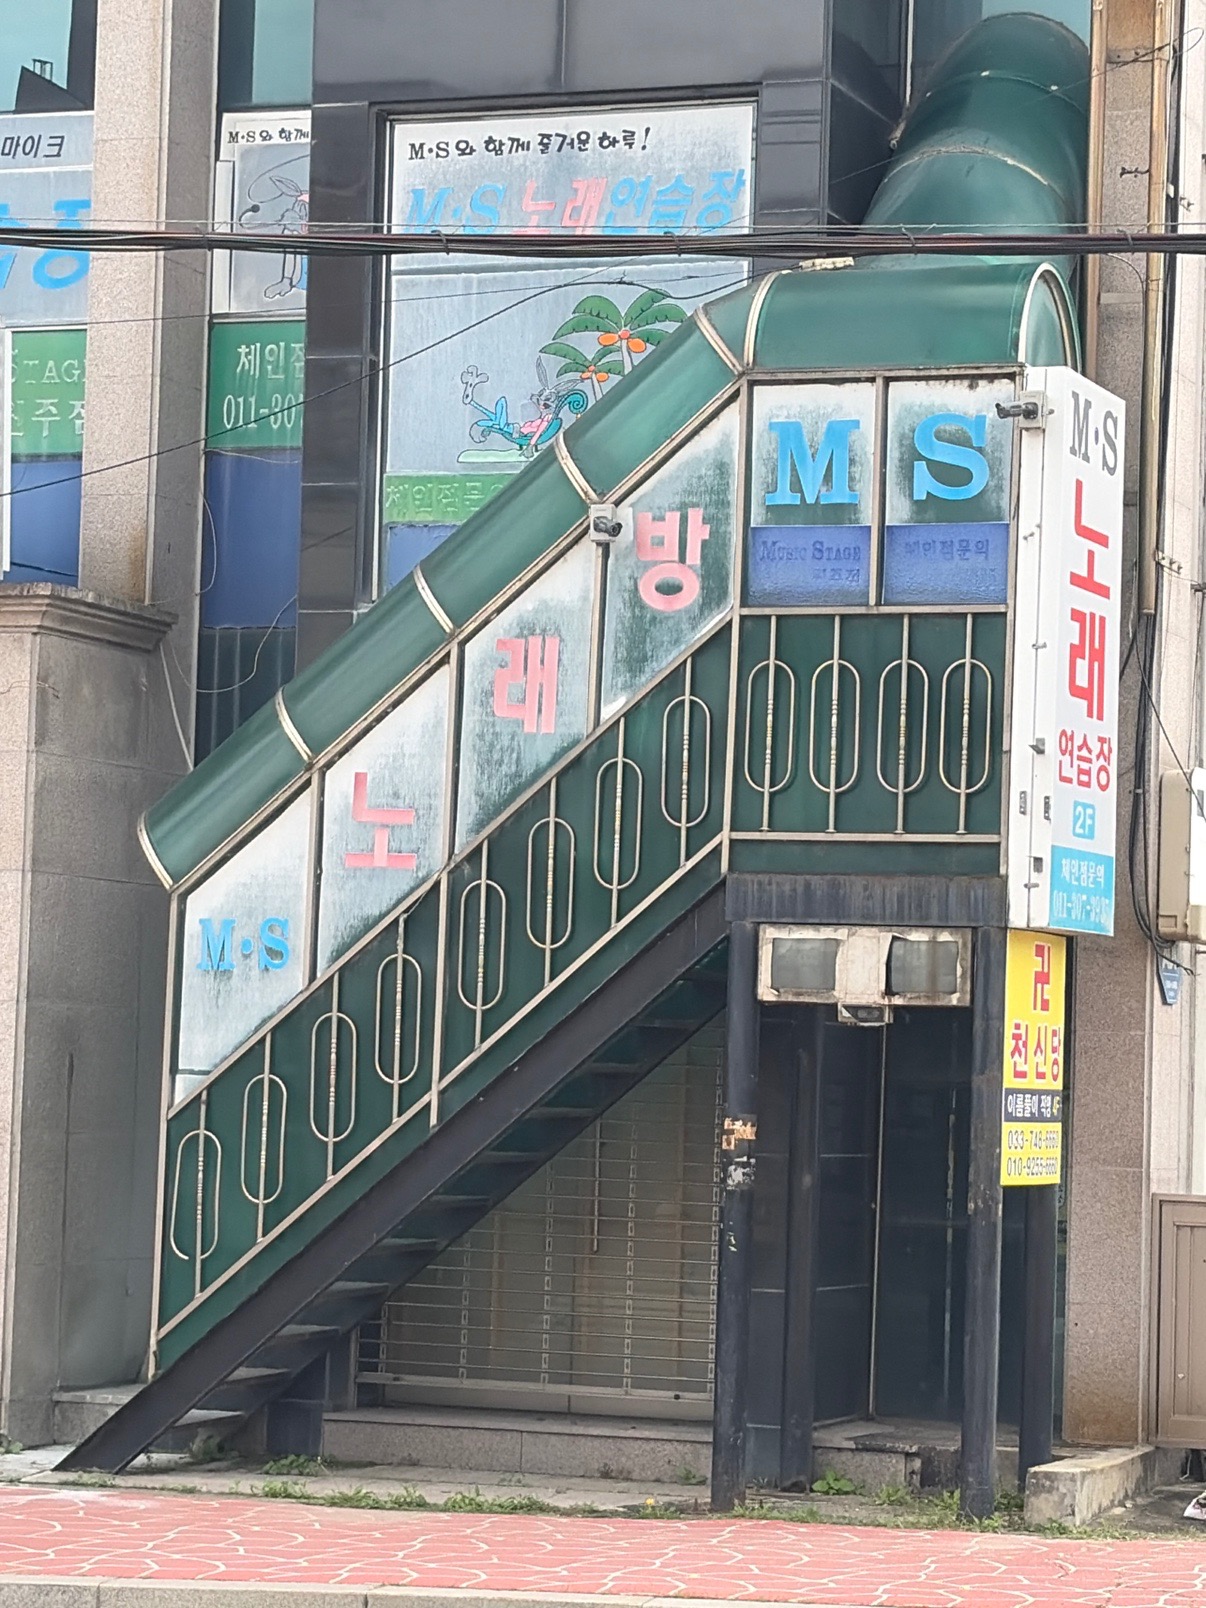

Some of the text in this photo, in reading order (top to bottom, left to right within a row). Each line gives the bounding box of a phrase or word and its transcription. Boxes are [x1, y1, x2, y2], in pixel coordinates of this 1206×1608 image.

[484, 135, 531, 157] 함께
[537, 130, 591, 155] 즐거운
[597, 126, 651, 152] 하루!
[402, 183, 507, 234] M·S
[1069, 390, 1118, 476] M·S
[1059, 728, 1113, 792] 연습장
[1074, 805, 1093, 835] 2F
[196, 917, 291, 971] M·S
[1007, 1093, 1039, 1118] 이름풀이
